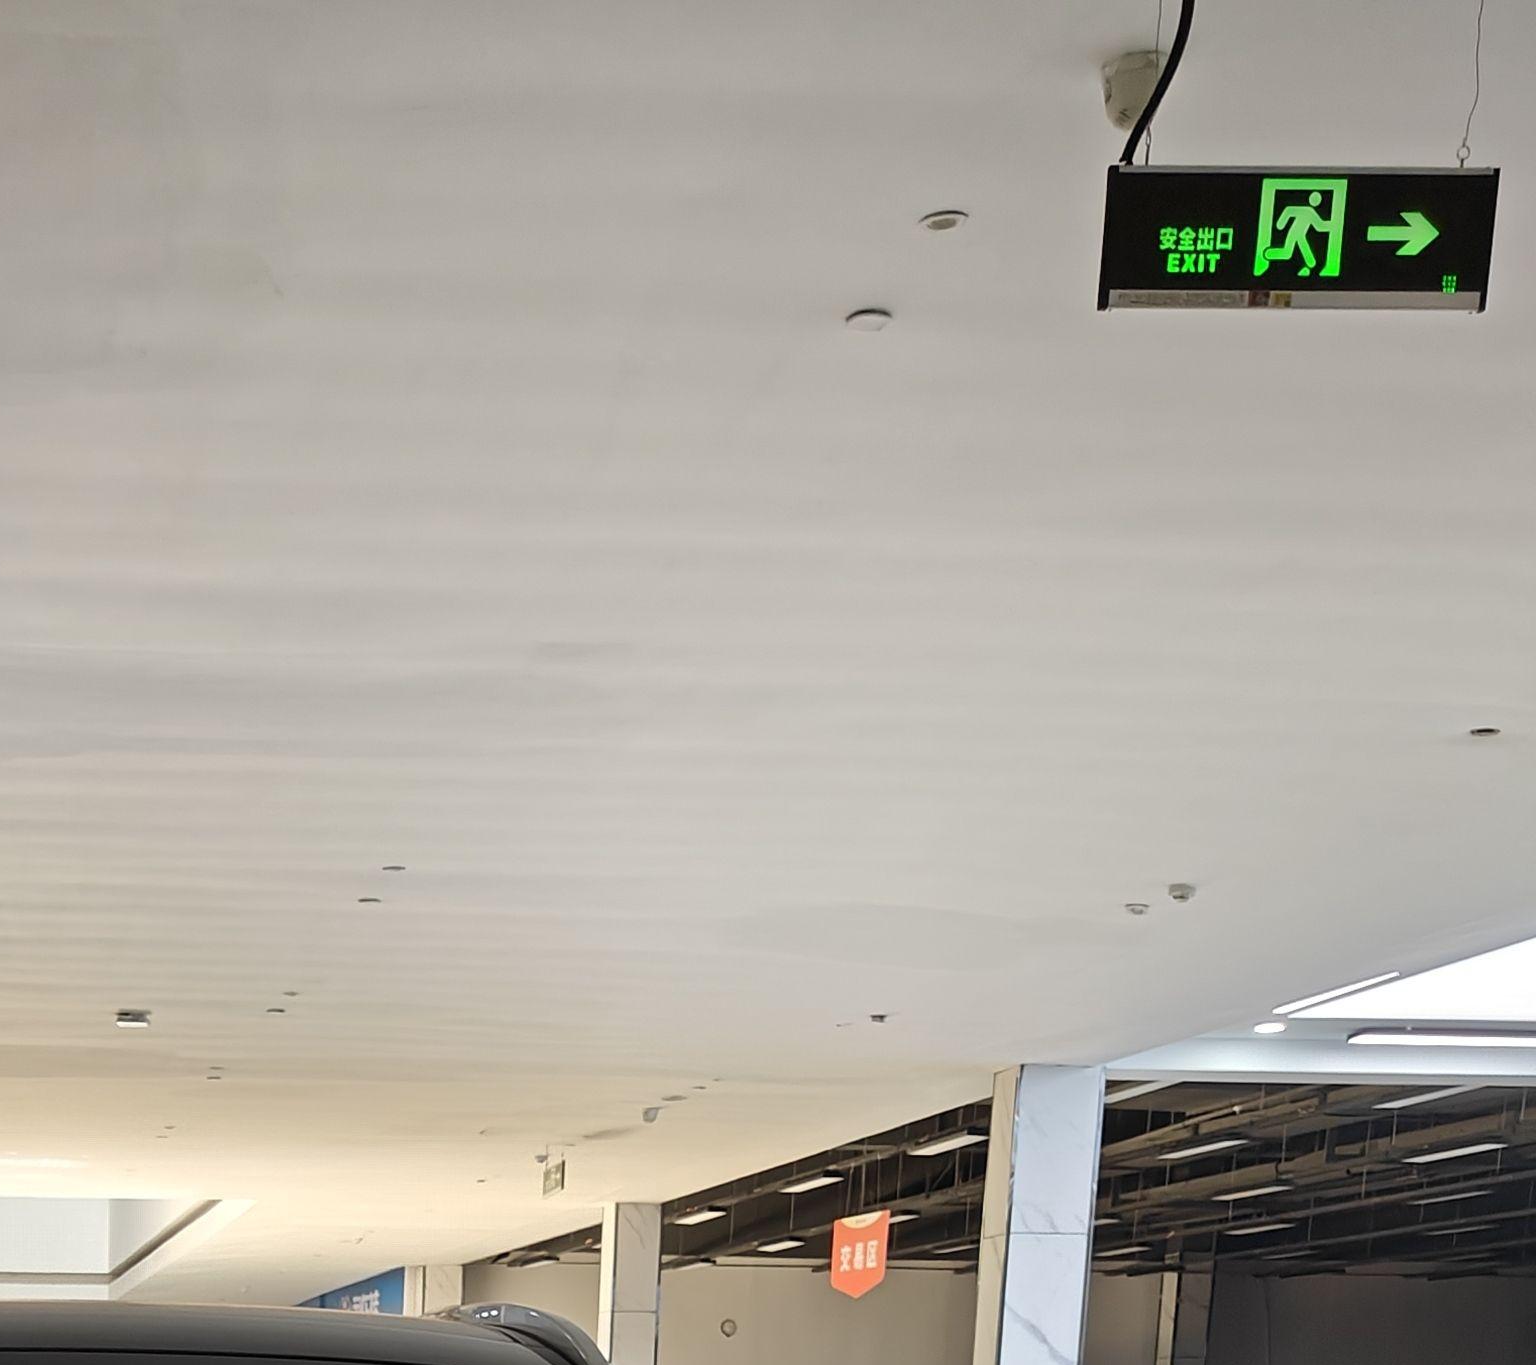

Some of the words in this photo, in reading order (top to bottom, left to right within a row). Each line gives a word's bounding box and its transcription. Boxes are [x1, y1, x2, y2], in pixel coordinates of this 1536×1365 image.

[1159, 227, 1233, 251] 安全出口
[1167, 253, 1220, 273] EXIT
